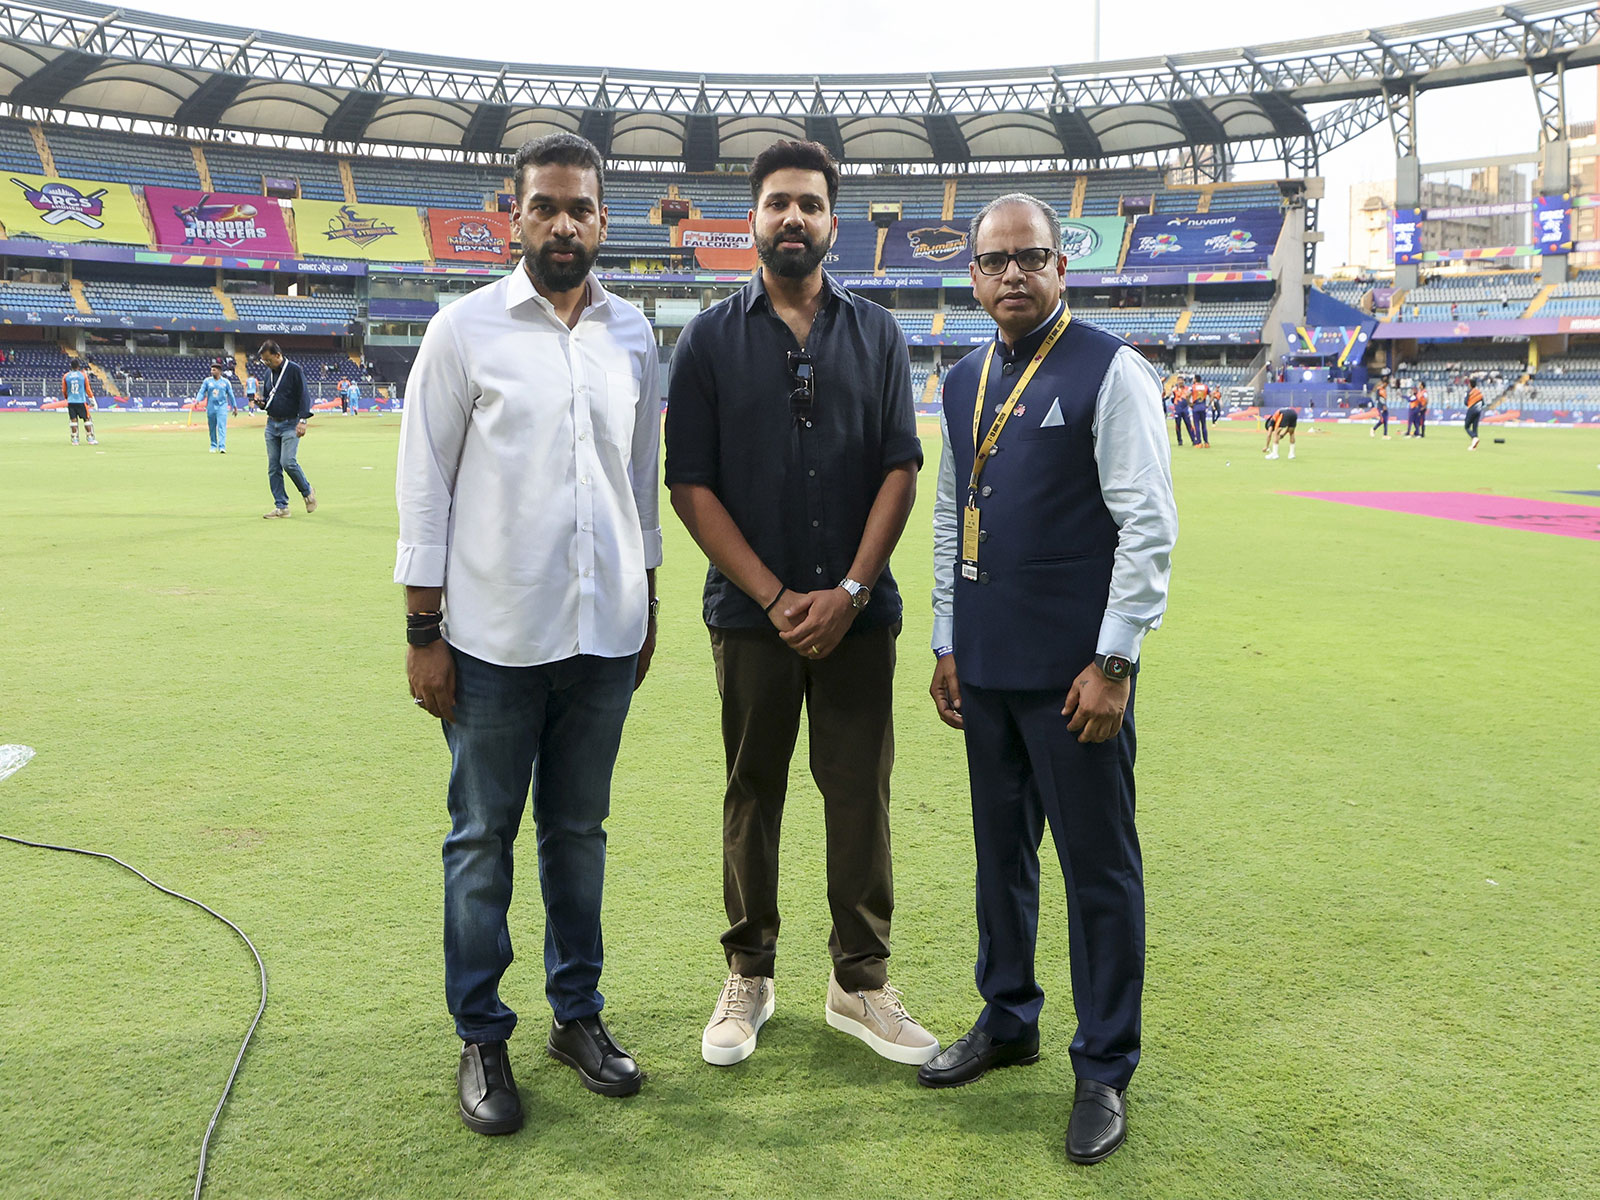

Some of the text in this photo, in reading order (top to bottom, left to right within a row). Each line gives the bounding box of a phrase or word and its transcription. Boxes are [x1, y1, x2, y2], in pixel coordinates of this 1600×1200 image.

[39, 194, 92, 208] ARCS
[196, 219, 255, 230] BANDRA
[1187, 215, 1236, 227] nuvama
[185, 227, 267, 239] BLASTERS
[455, 245, 502, 254] ROYALS
[684, 240, 740, 248] FALCONS
[915, 240, 966, 252] MUMBAI
[915, 246, 965, 256] PANTHERS
